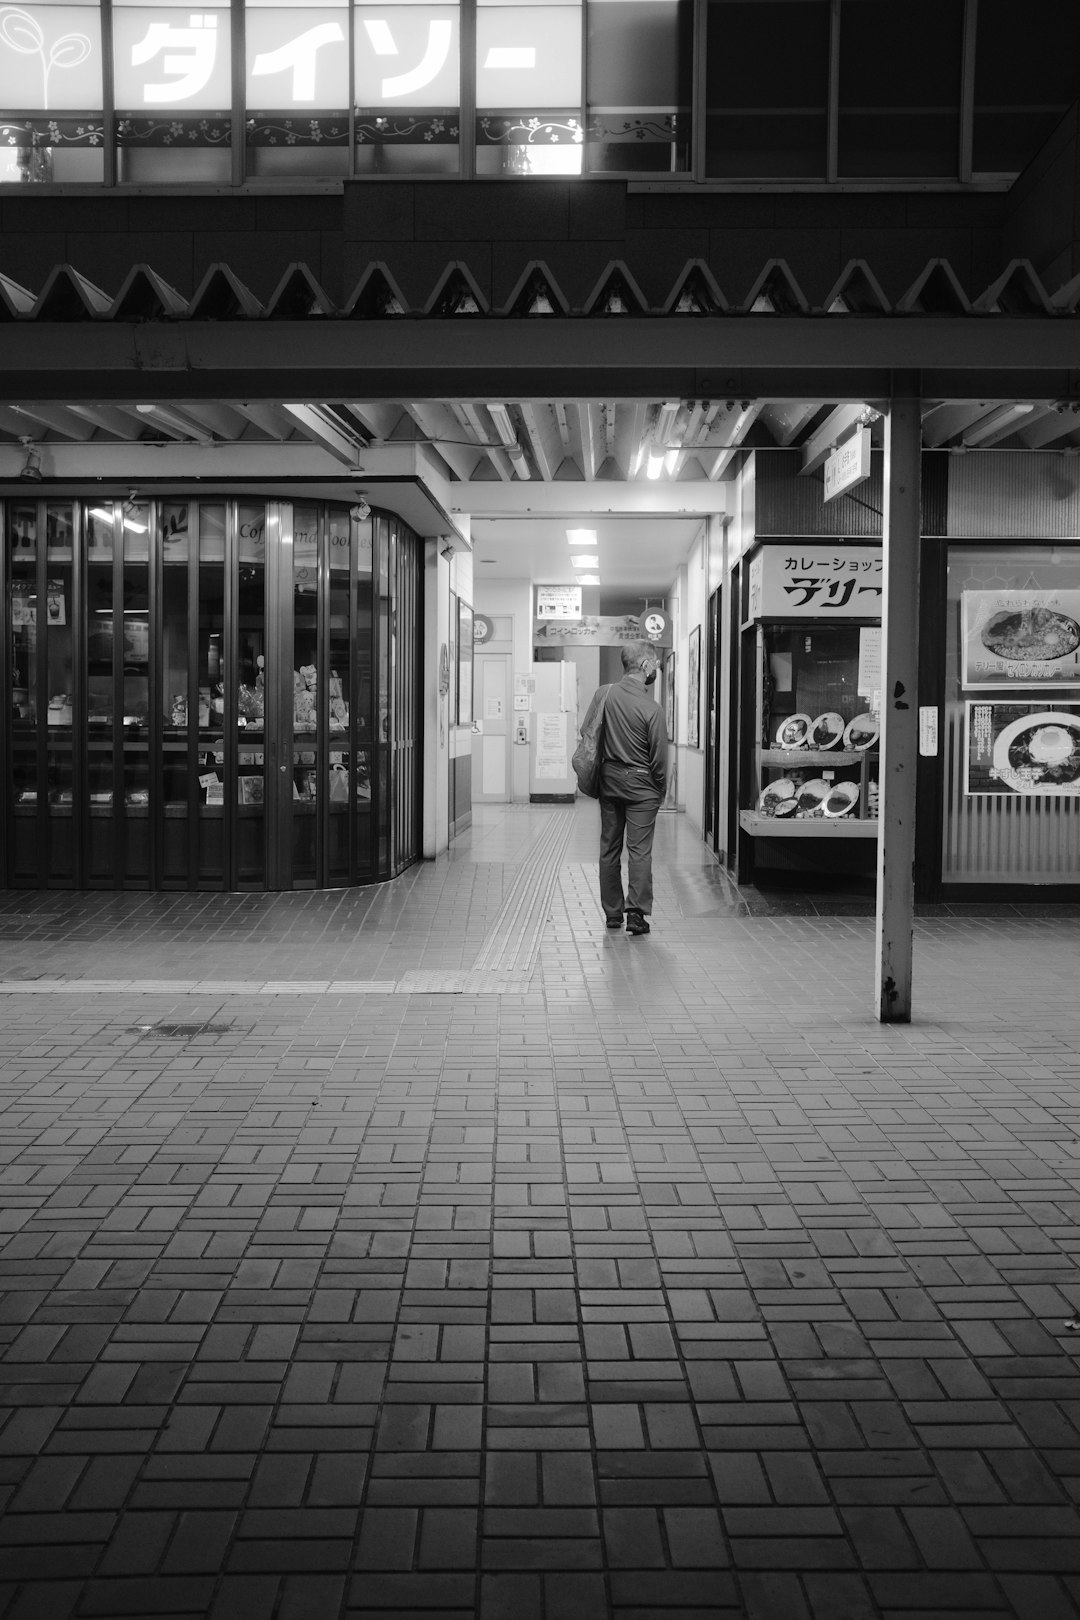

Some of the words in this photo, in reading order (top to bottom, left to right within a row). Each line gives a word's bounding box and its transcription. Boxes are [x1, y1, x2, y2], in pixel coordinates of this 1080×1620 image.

[131, 14, 536, 104] ダイソー
[782, 577, 883, 608] デリー
[550, 627, 598, 636] コインロッカー
[1016, 779, 1057, 790] カレー
